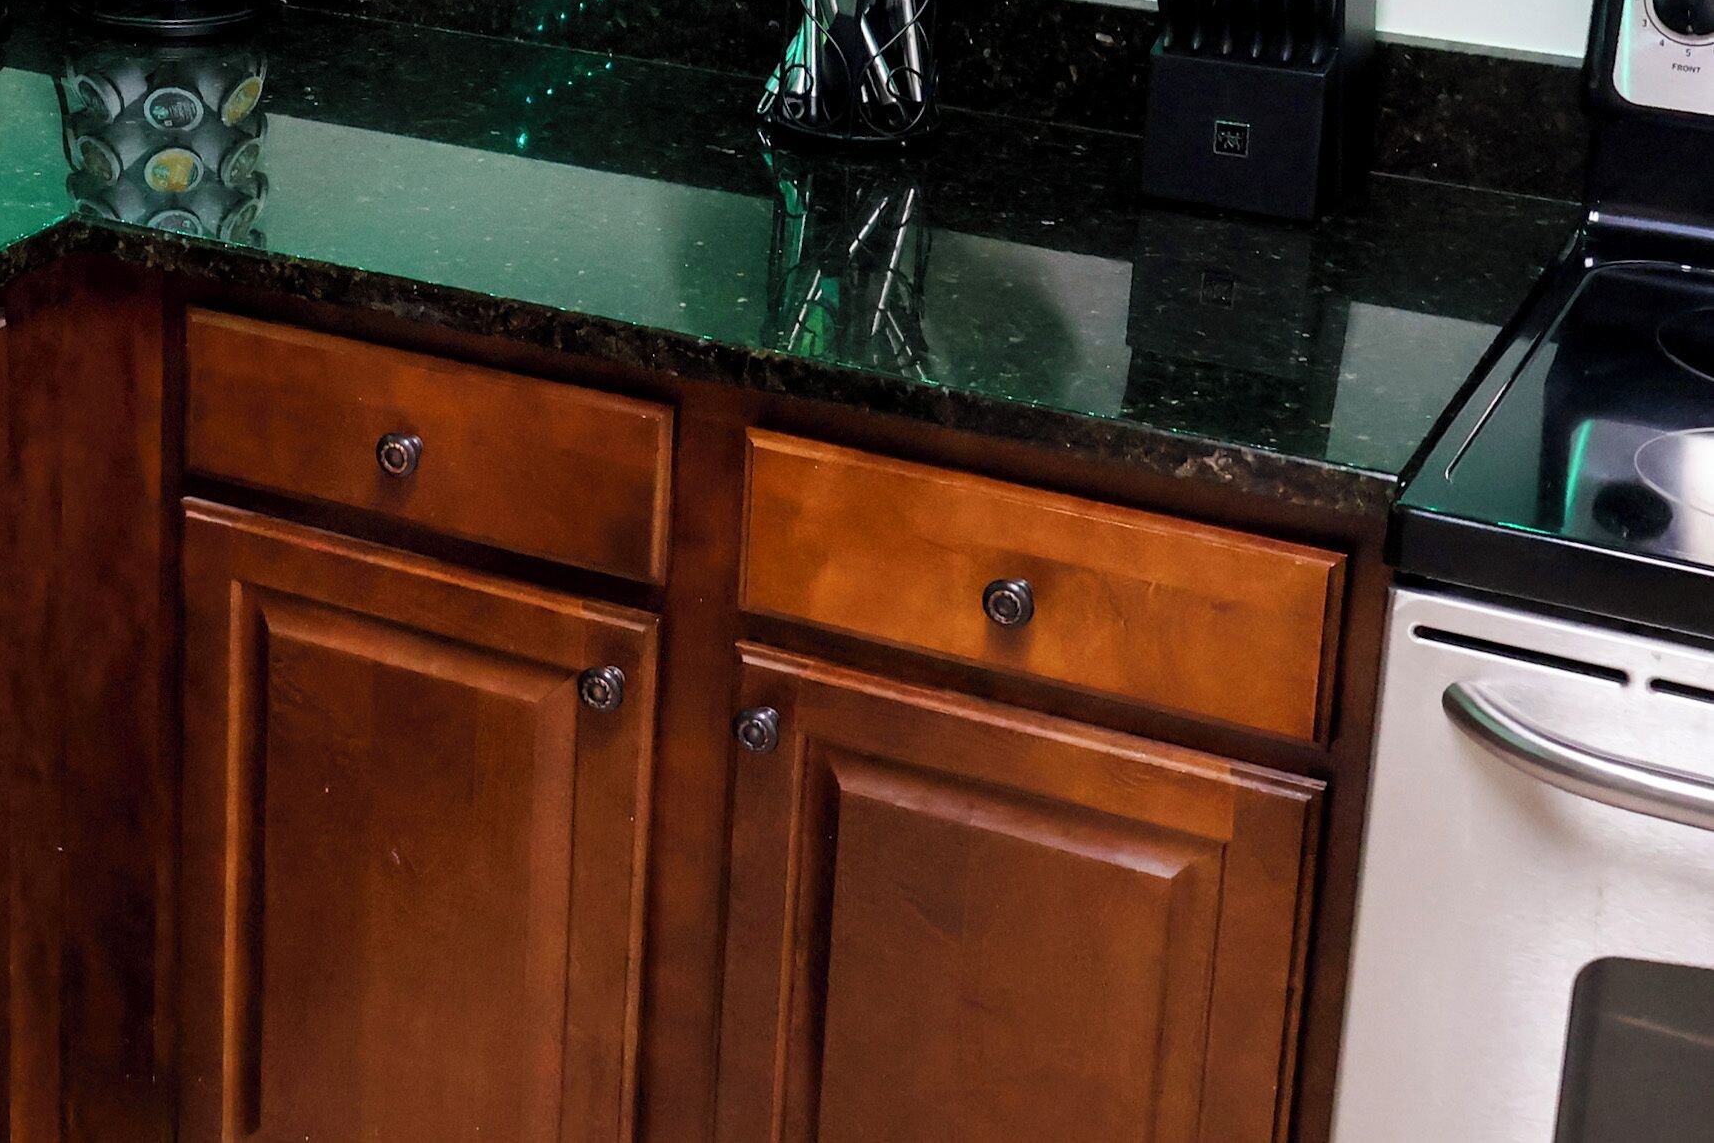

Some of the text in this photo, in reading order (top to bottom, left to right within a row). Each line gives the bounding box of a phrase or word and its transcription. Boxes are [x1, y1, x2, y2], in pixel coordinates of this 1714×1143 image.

[1642, 19, 1647, 28] 3
[1659, 39, 1665, 47] 4
[1686, 49, 1691, 58] 5
[1672, 62, 1701, 74] FRONT
